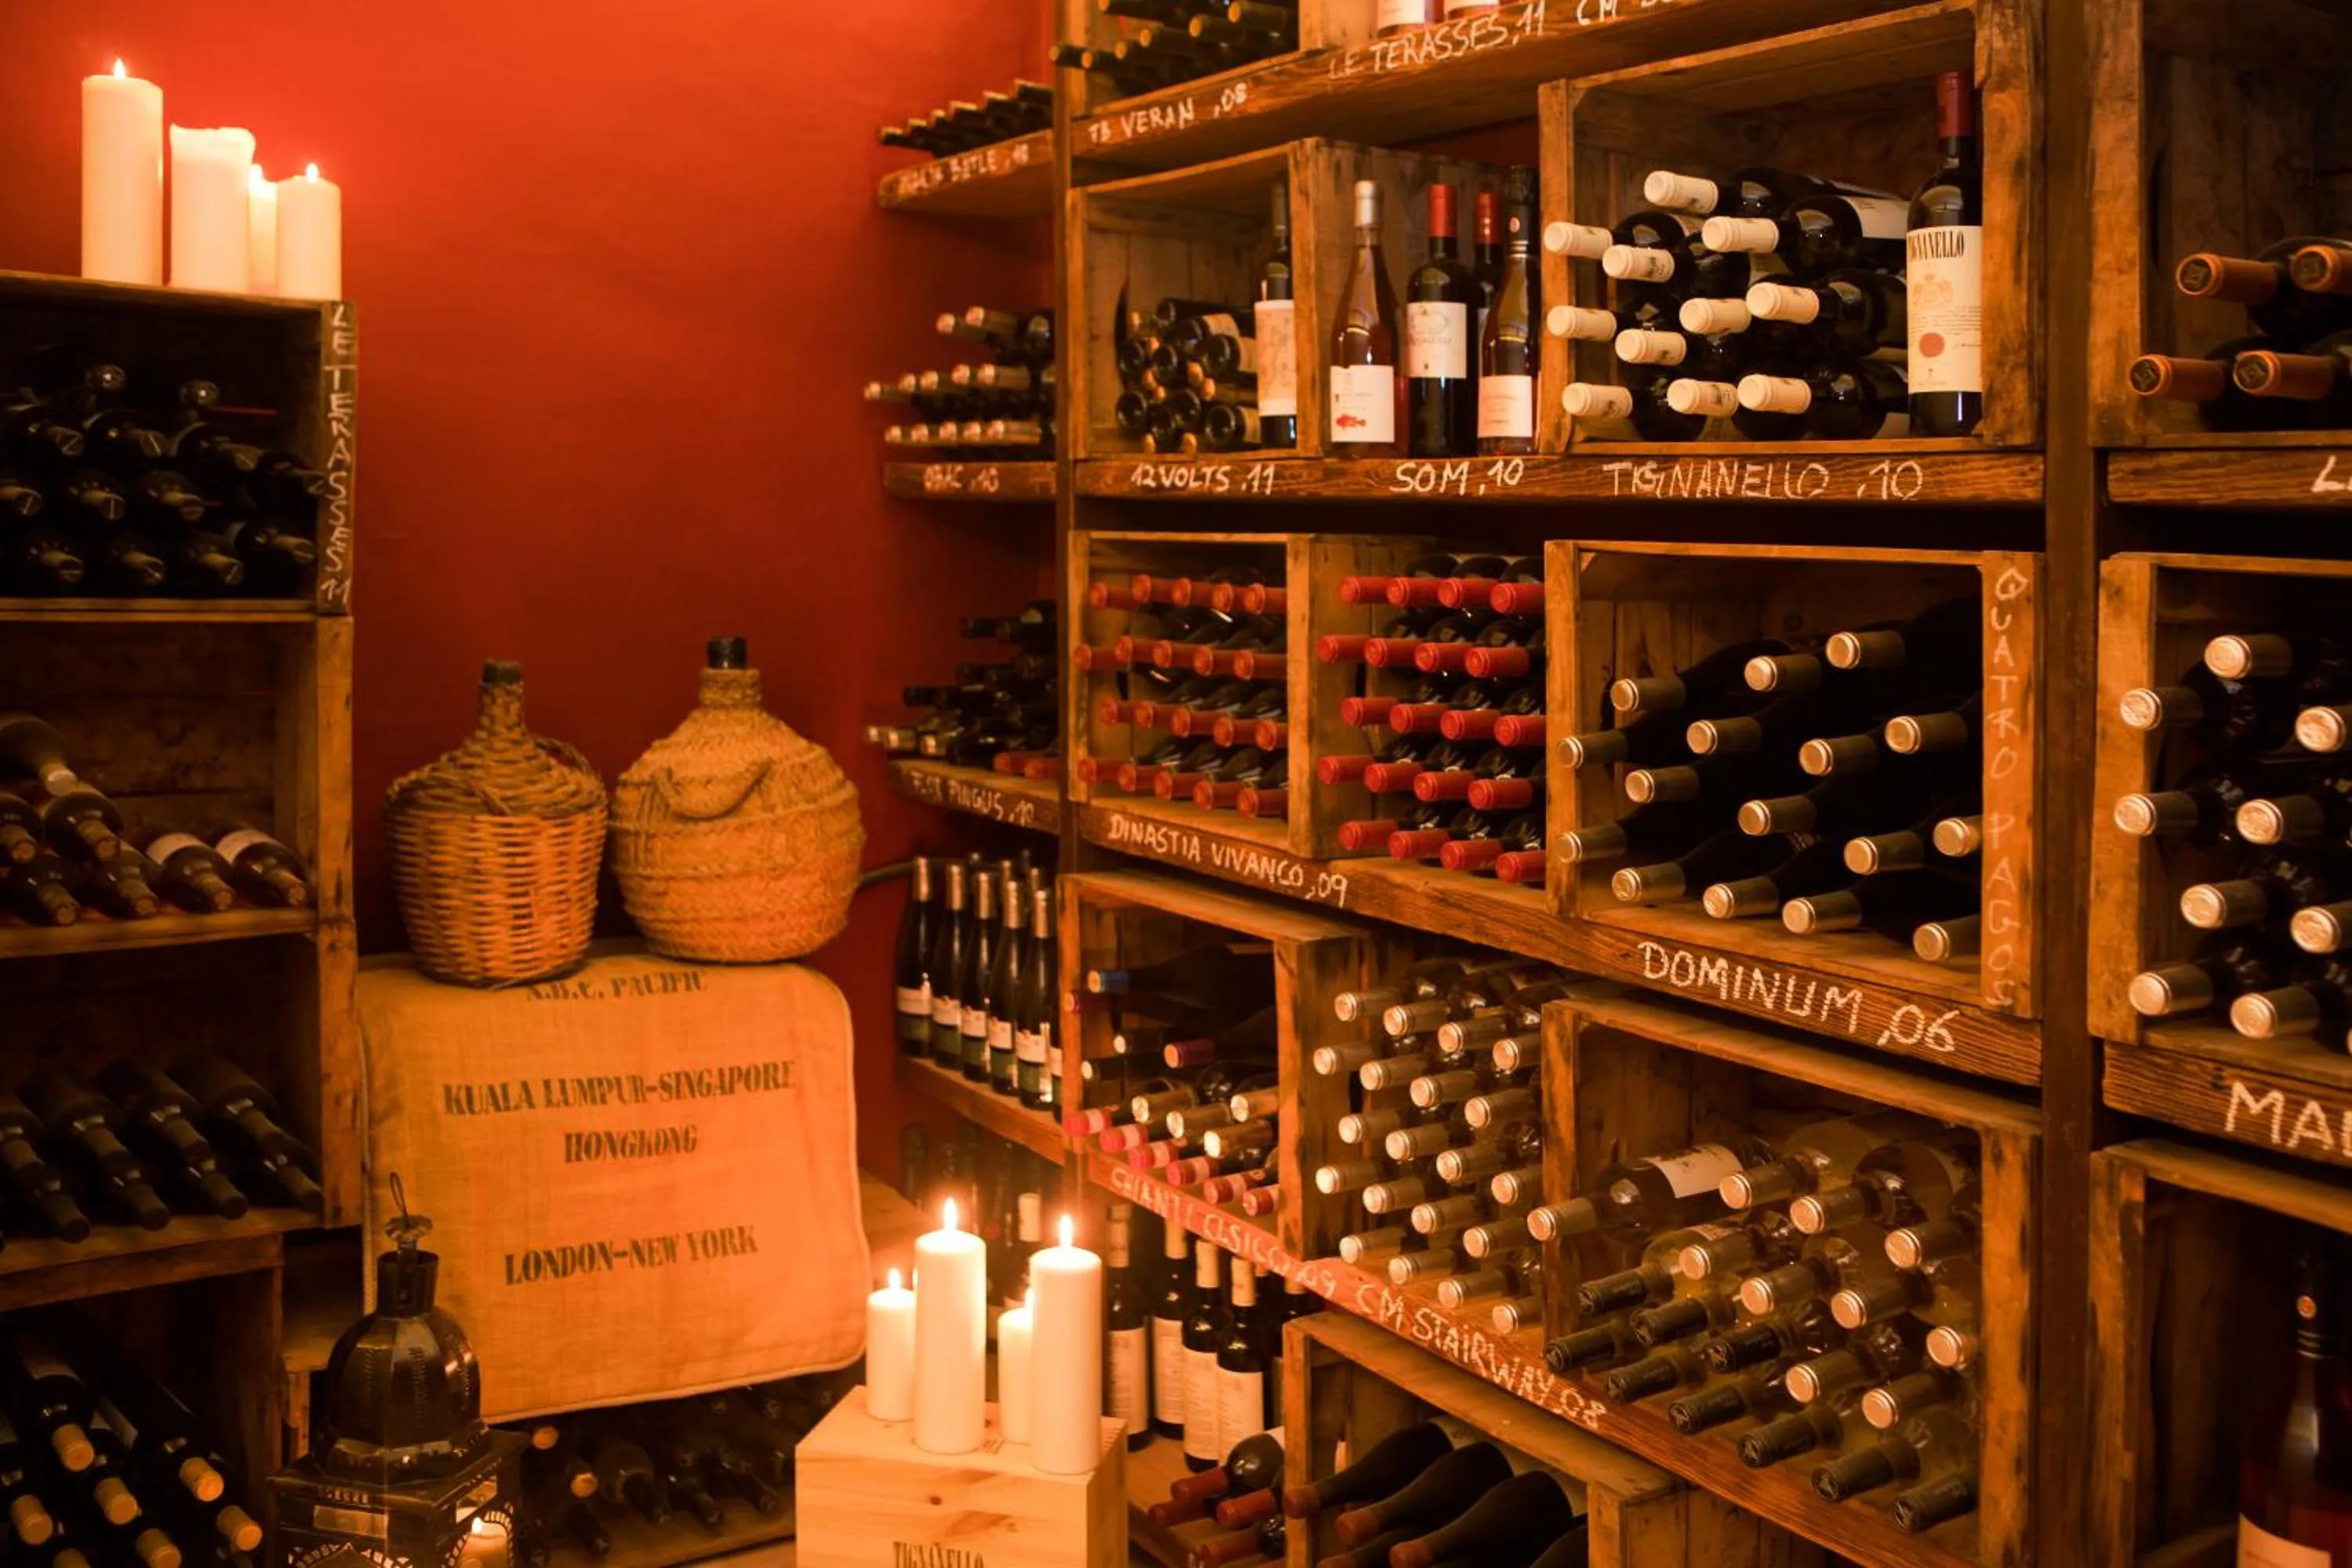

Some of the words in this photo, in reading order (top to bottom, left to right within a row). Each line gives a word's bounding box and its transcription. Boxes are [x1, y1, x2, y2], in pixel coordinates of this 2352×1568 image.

[1329, 52, 1364, 79] LE
[1120, 97, 1195, 139] VERAN
[1602, 460, 1831, 499] TIGNANELLO
[2310, 455, 2352, 493] L
[1108, 814, 1201, 862] DINASTIA
[1638, 941, 1863, 1034] DOMINUM
[441, 1078, 536, 1116] KUALA
[564, 1124, 698, 1163] HONGKONG
[686, 1224, 758, 1262] YORK
[1356, 1283, 1404, 1334] CM
